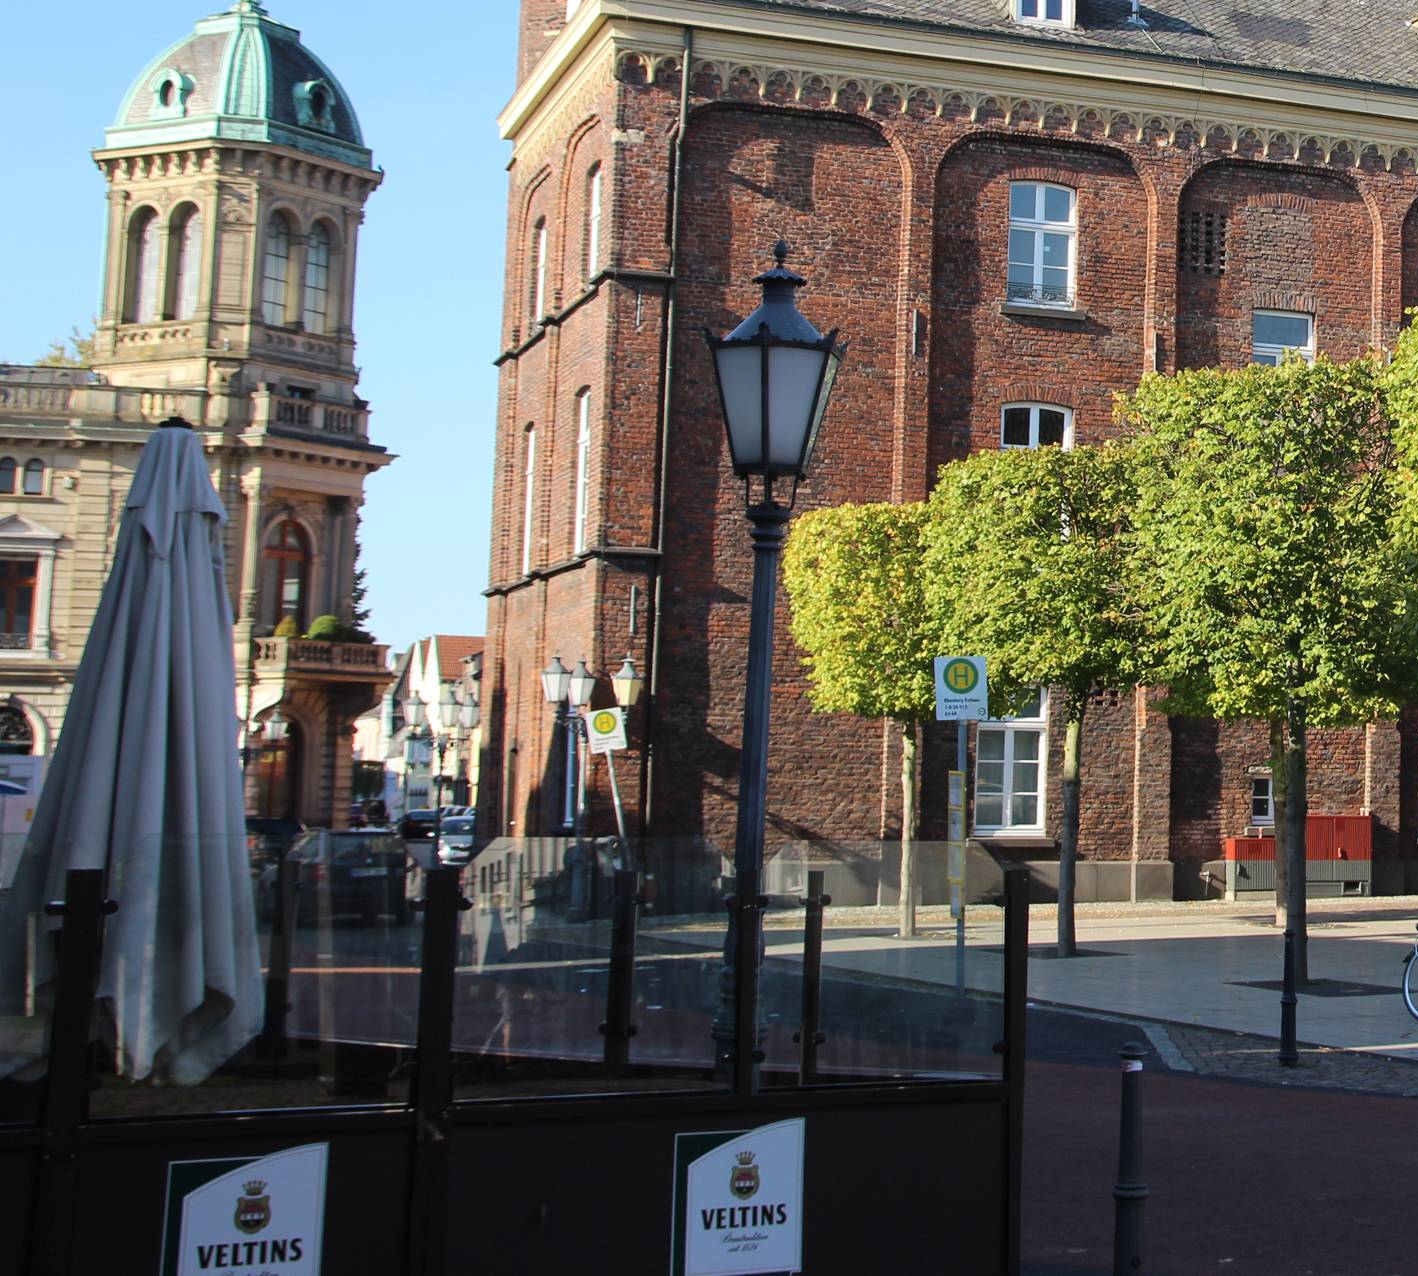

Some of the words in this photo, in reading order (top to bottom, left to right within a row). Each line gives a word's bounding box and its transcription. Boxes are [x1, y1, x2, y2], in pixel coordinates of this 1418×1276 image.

[953, 666, 969, 686] H
[701, 1203, 788, 1231] VELTINS
[196, 1237, 304, 1270] VELTINS
